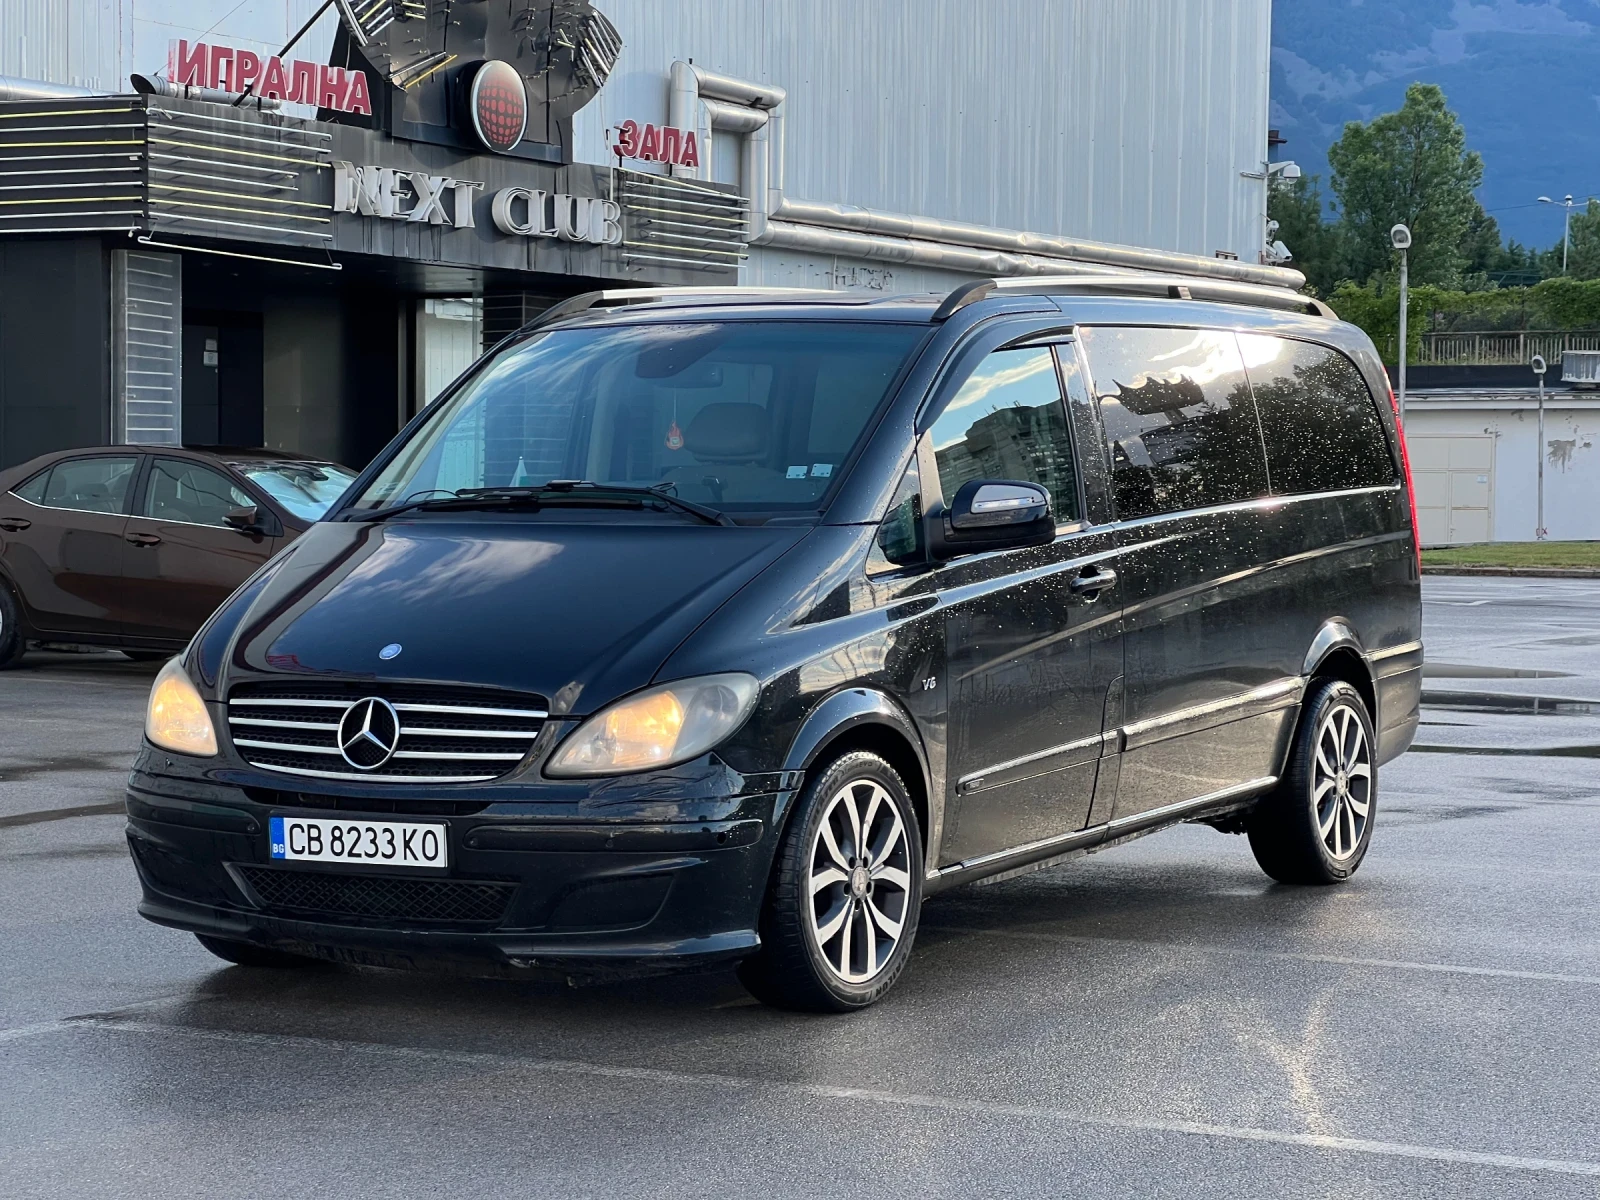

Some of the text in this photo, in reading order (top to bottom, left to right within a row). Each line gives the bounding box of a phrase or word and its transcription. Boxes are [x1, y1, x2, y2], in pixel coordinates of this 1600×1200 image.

[170, 38, 373, 116] ИГРАЛНА
[613, 118, 700, 168] ЗАЛА
[331, 160, 623, 245] NEXT CLUB
[921, 676, 937, 691] V6
[272, 843, 285, 854] BG
[289, 823, 324, 856] CB
[330, 825, 397, 860] 8233
